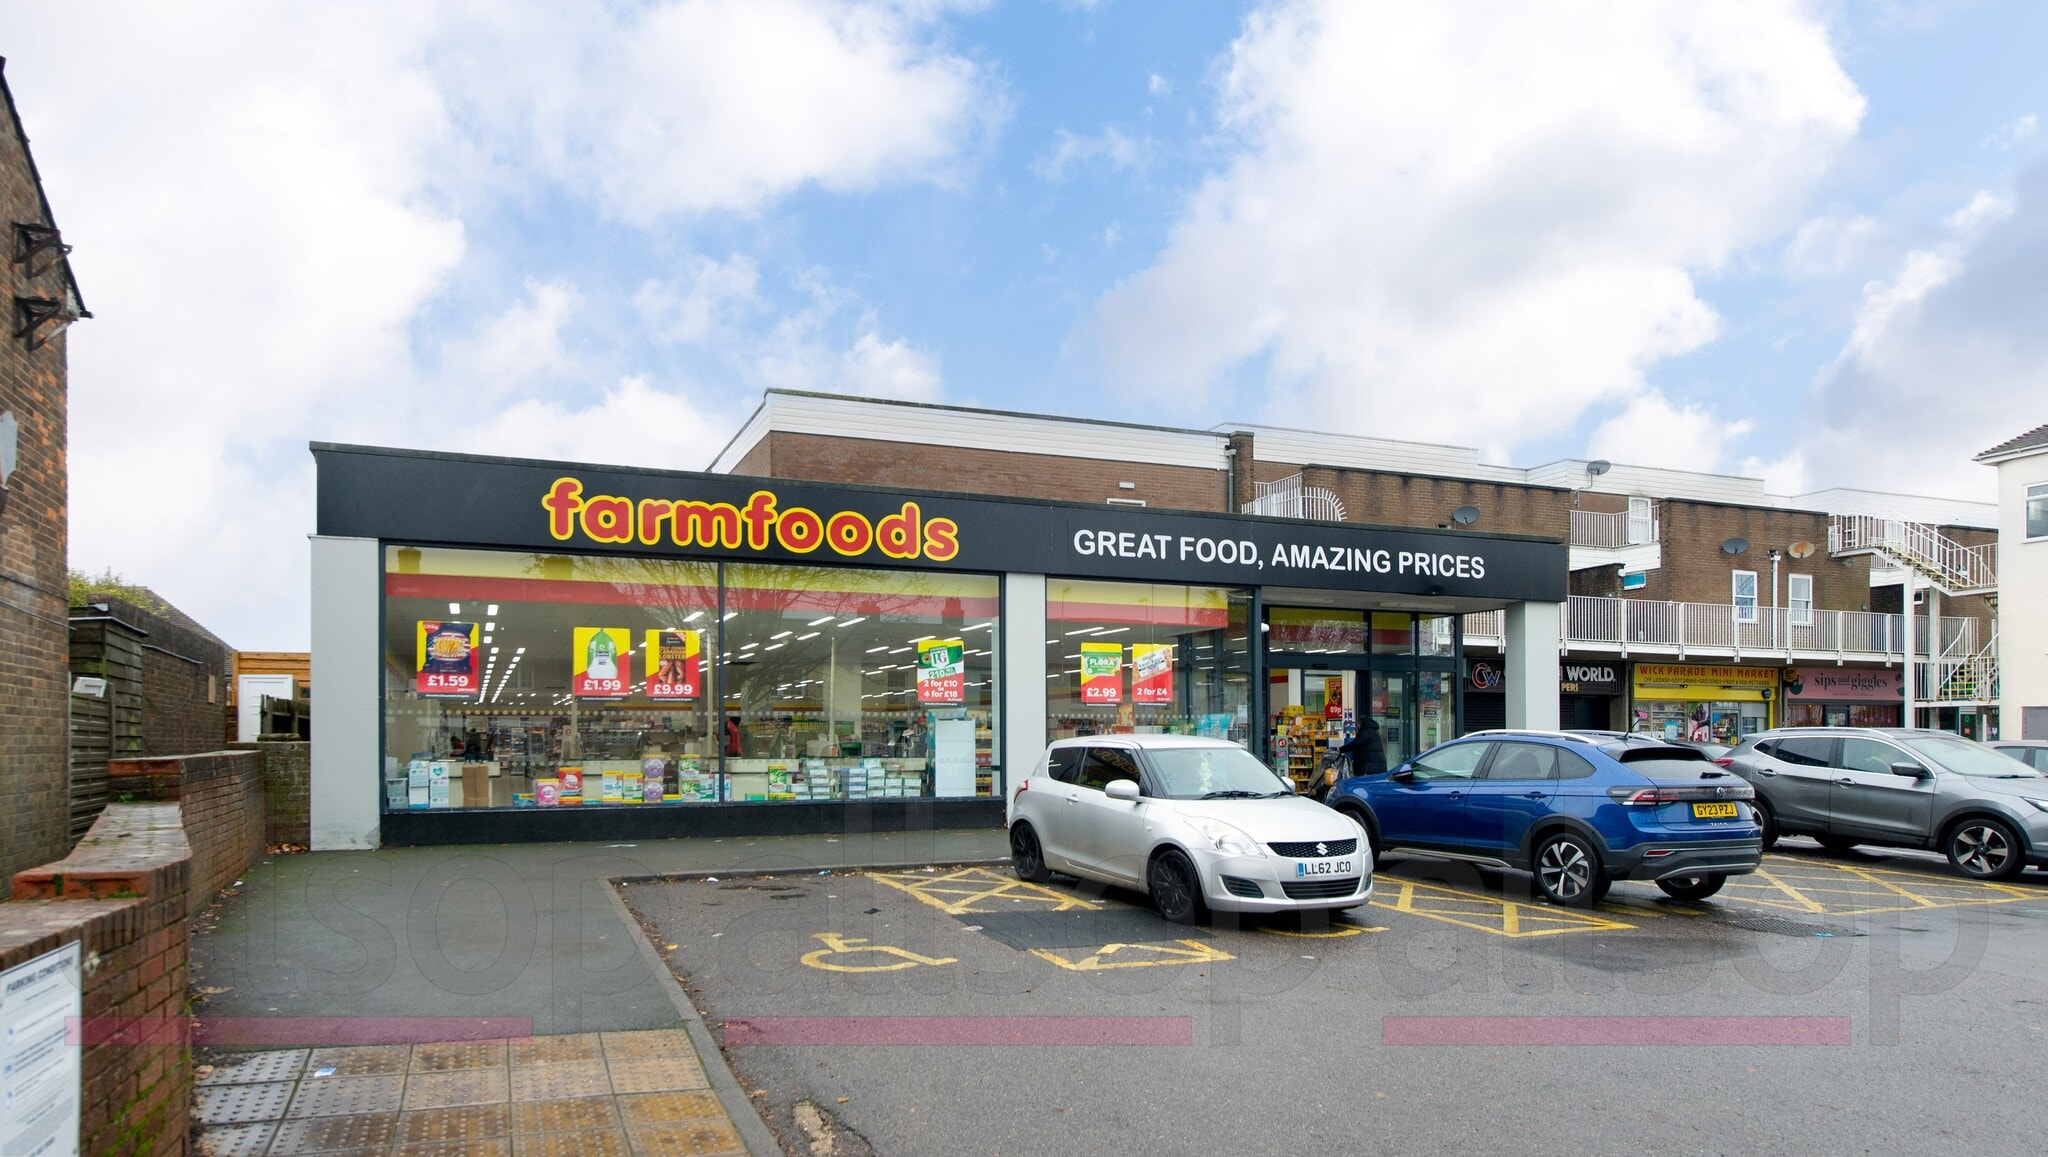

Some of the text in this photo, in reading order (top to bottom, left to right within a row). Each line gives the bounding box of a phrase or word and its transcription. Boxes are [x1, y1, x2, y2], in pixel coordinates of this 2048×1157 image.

[541, 477, 960, 561] farmfoods
[1073, 529, 1485, 579] GREAT FOOD, AMAZING PRICES
[932, 651, 947, 665] PG
[1089, 658, 1115, 666] FLORA
[929, 669, 945, 679] 210
[1639, 665, 1664, 675] WICK
[1667, 667, 1706, 676] PARADE
[1711, 667, 1733, 677] MINI
[1737, 669, 1775, 678] MARKET
[427, 675, 469, 687] £1.59
[583, 680, 622, 691] £1.99
[1814, 673, 1837, 690] sips
[1850, 673, 1888, 691] giggles
[653, 684, 693, 695] £9.99
[1086, 687, 1117, 697] £2.99
[1136, 687, 1168, 696] 2 for £4
[1561, 682, 1579, 692] PERI
[931, 690, 943, 698] for
[944, 690, 958, 698] £18
[1696, 804, 1734, 816] GY23 PZJ
[1304, 861, 1351, 875] LL62 JCO
